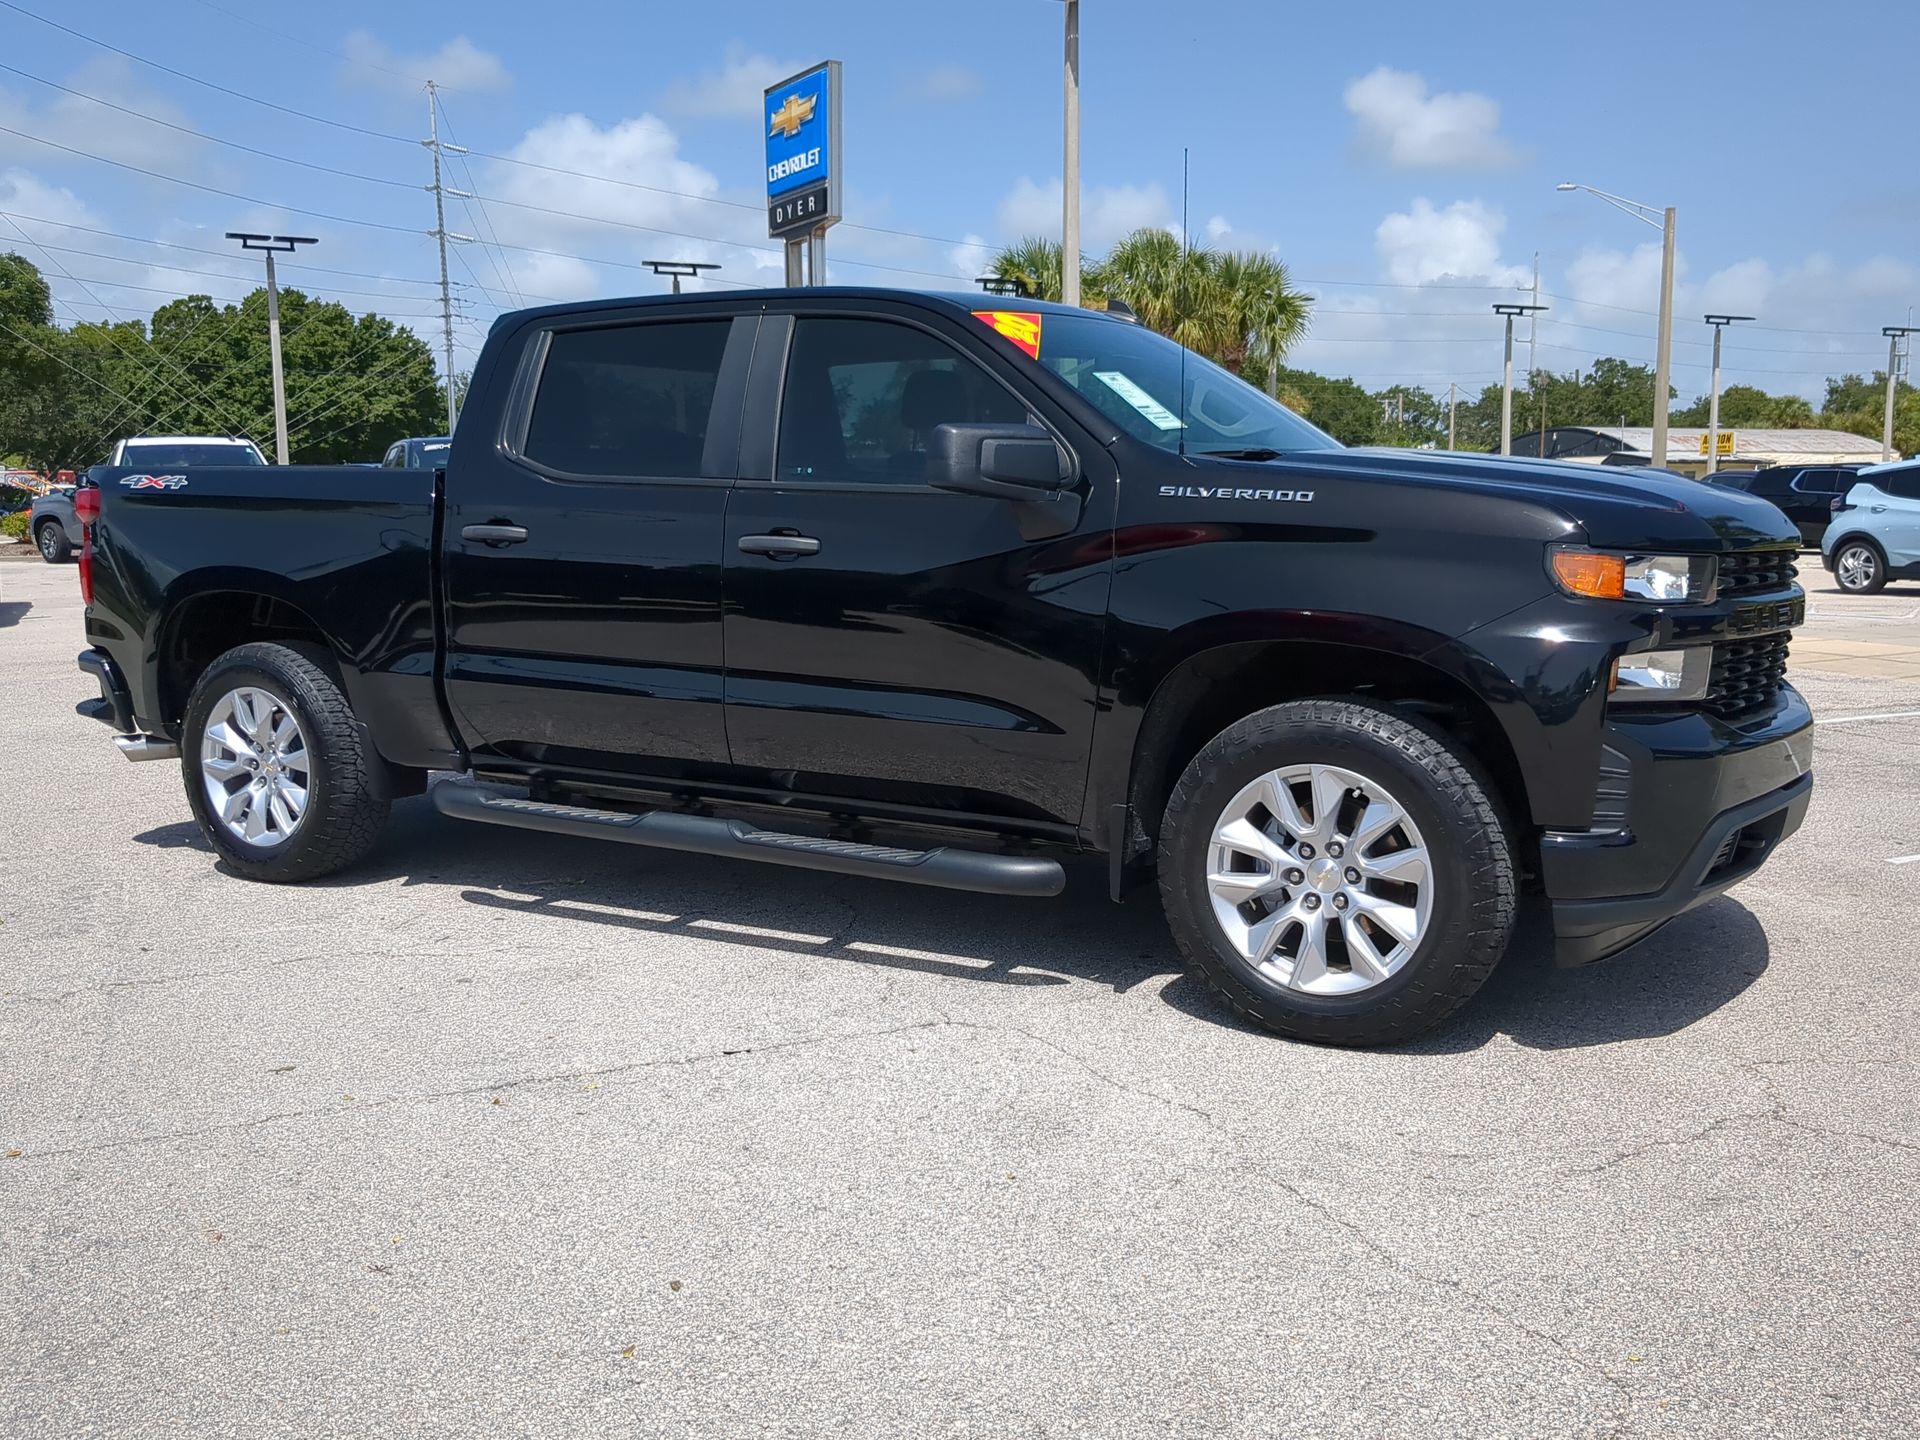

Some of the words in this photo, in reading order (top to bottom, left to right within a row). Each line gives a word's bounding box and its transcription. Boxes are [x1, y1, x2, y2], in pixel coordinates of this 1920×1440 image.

[769, 147, 821, 182] CHEVROLET
[776, 196, 815, 223] DYER
[1702, 434, 1732, 445] AION
[1158, 486, 1315, 502] SILVERADO
